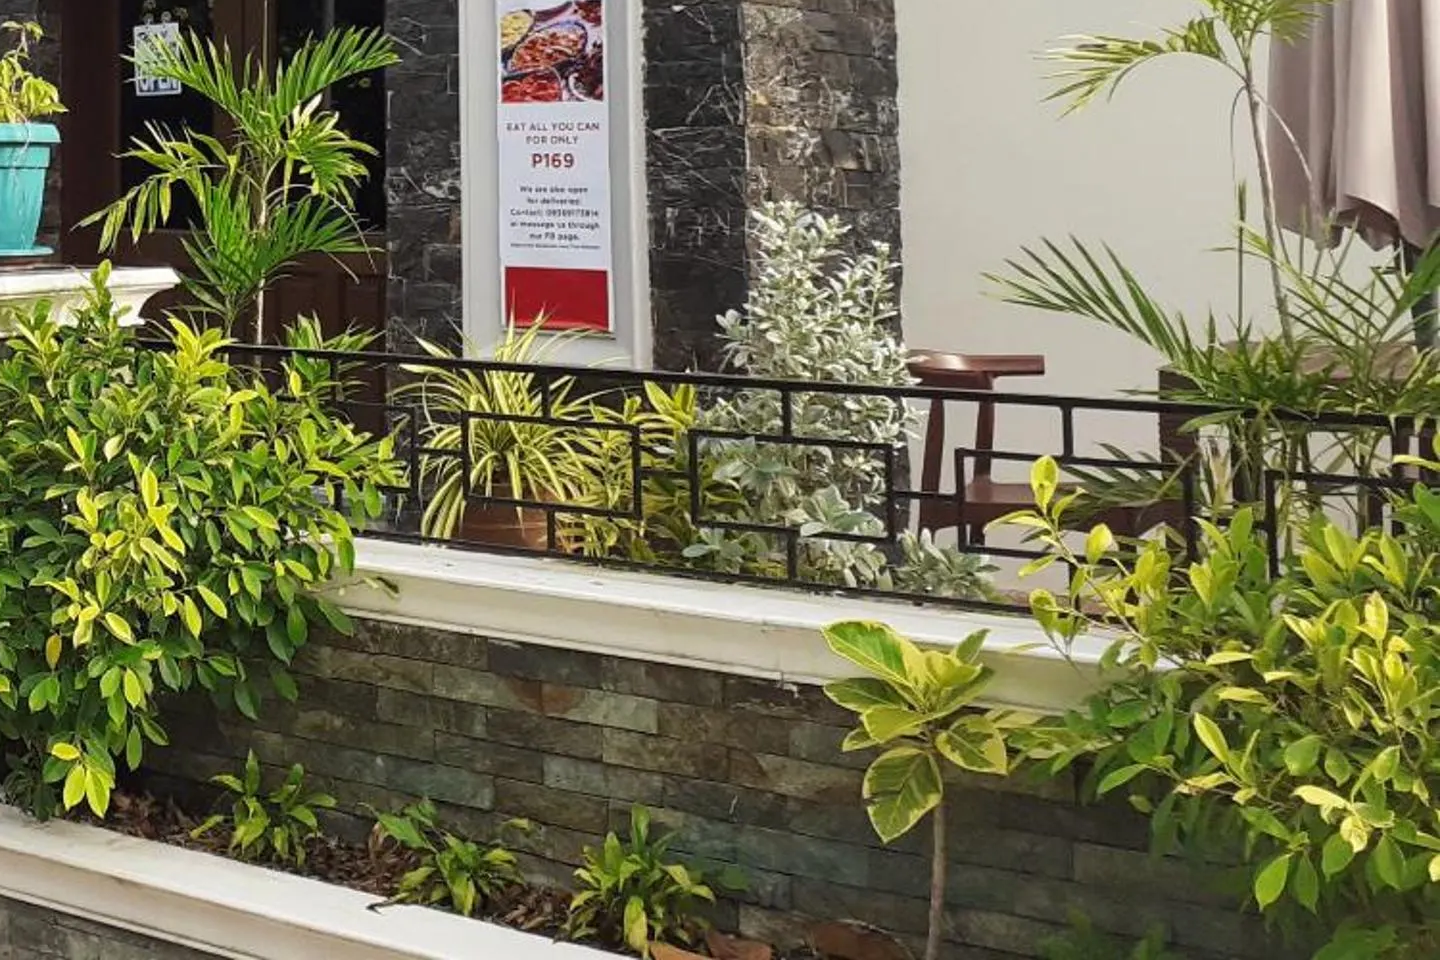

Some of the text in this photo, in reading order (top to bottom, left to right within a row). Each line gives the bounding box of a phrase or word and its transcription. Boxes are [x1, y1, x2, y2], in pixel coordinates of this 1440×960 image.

[506, 122, 600, 132] EAT ALL YOU CAN
[525, 135, 578, 145] FOR ONLY
[532, 152, 575, 168] P169
